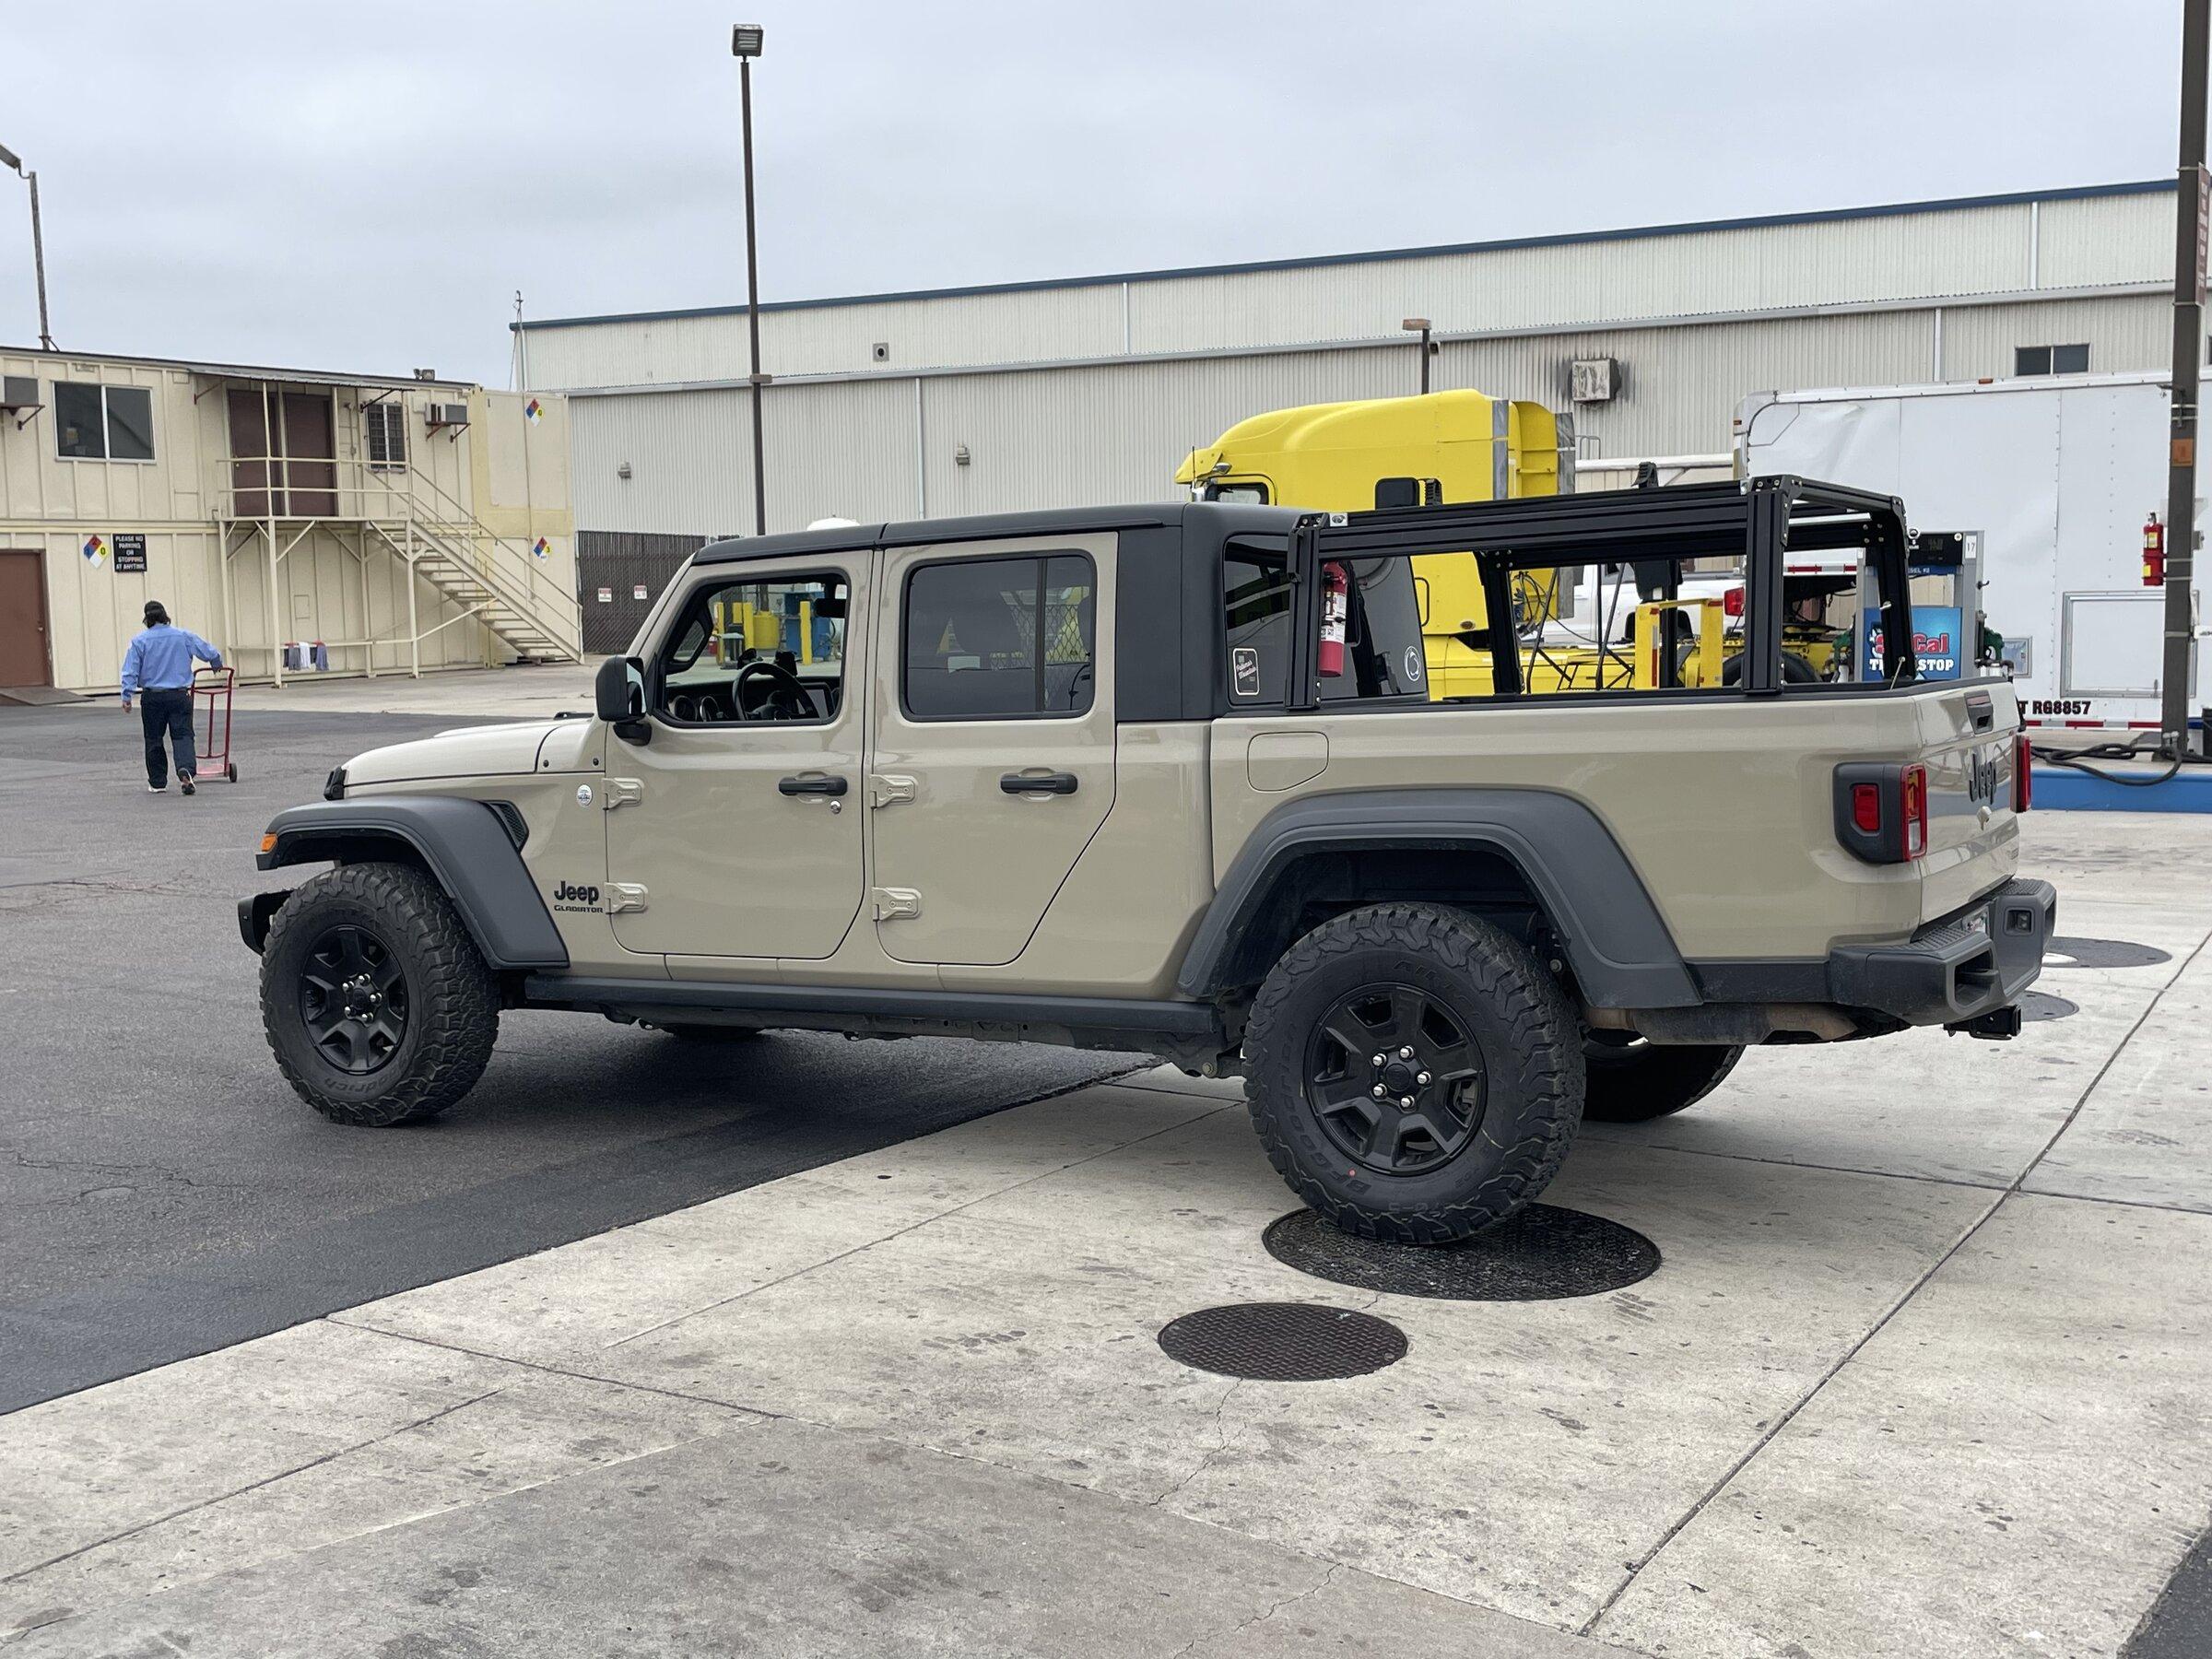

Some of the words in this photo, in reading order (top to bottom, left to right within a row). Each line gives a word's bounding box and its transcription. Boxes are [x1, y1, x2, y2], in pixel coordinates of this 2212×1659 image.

[1967, 543, 1975, 551] 17
[1917, 658, 1955, 672] STOP
[2032, 700, 2091, 715] RG8857
[554, 880, 599, 905] Jeep
[554, 904, 604, 913] GLADIATOR
